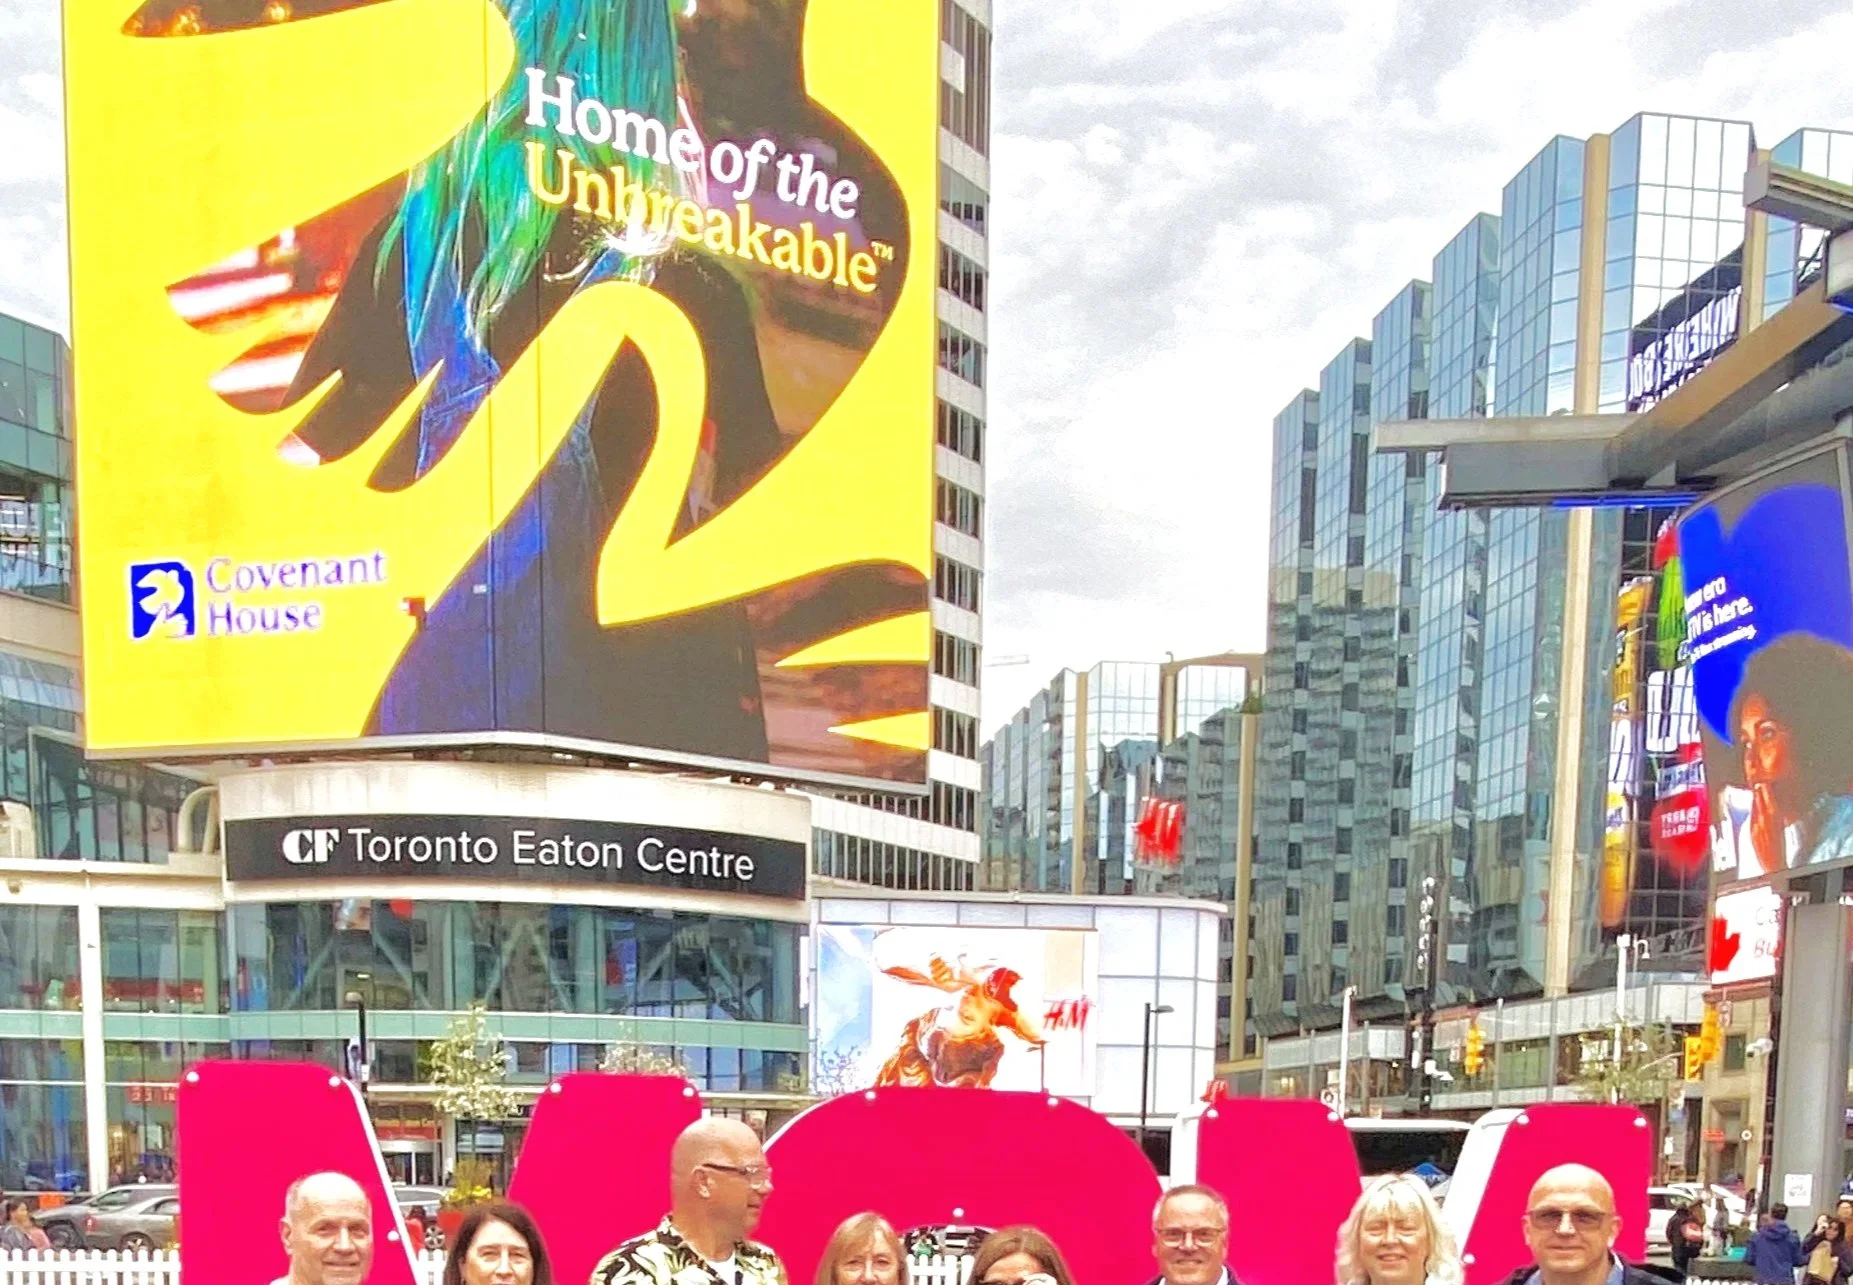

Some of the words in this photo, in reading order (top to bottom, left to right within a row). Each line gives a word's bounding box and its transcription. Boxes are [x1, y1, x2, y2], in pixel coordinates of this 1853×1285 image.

[525, 67, 704, 172] Home
[710, 139, 776, 200] of
[777, 153, 859, 219] the
[206, 551, 387, 593] Covenant
[206, 600, 321, 637] House
[282, 828, 340, 863] CF
[348, 828, 498, 864] Toronto
[513, 830, 623, 869] Eaton
[637, 837, 754, 880] Centre
